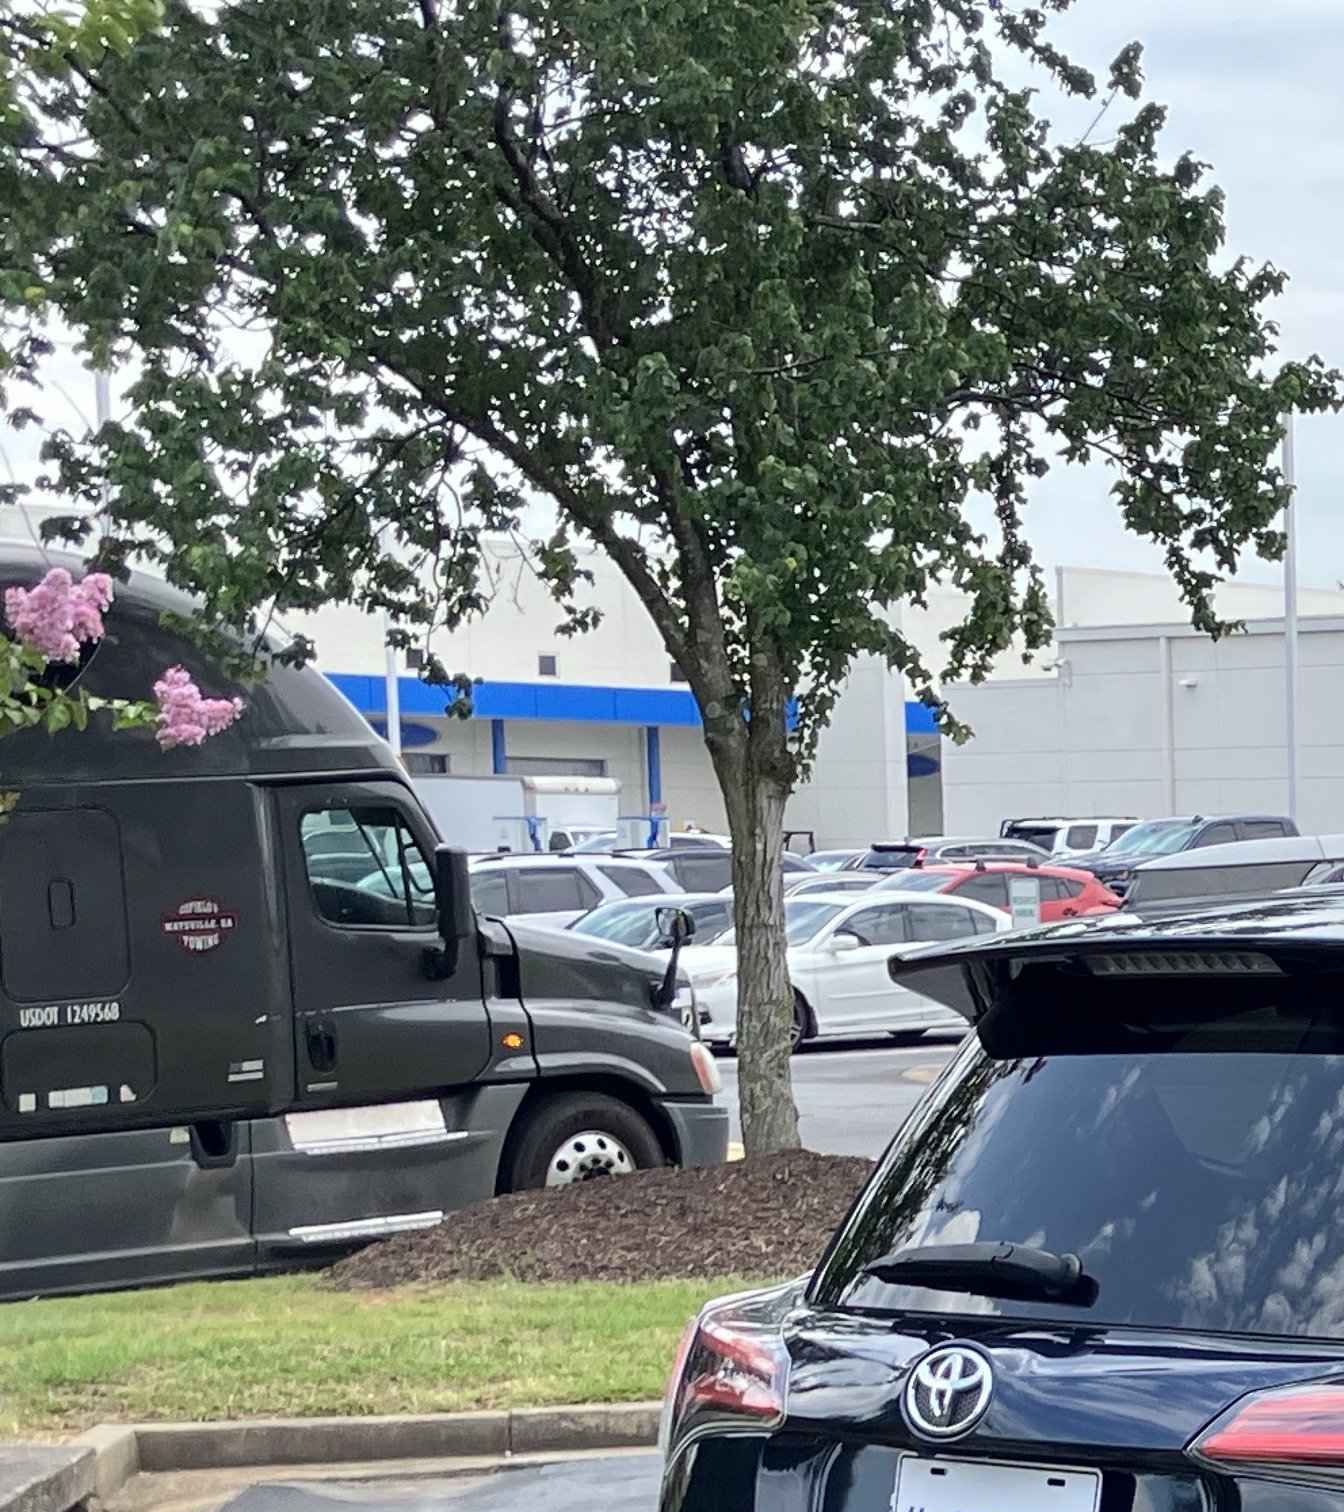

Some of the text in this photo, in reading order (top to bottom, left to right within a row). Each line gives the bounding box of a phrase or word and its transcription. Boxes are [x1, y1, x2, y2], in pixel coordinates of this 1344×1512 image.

[182, 933, 219, 951] TOWING
[20, 1002, 120, 1027] USDOT 1249568
